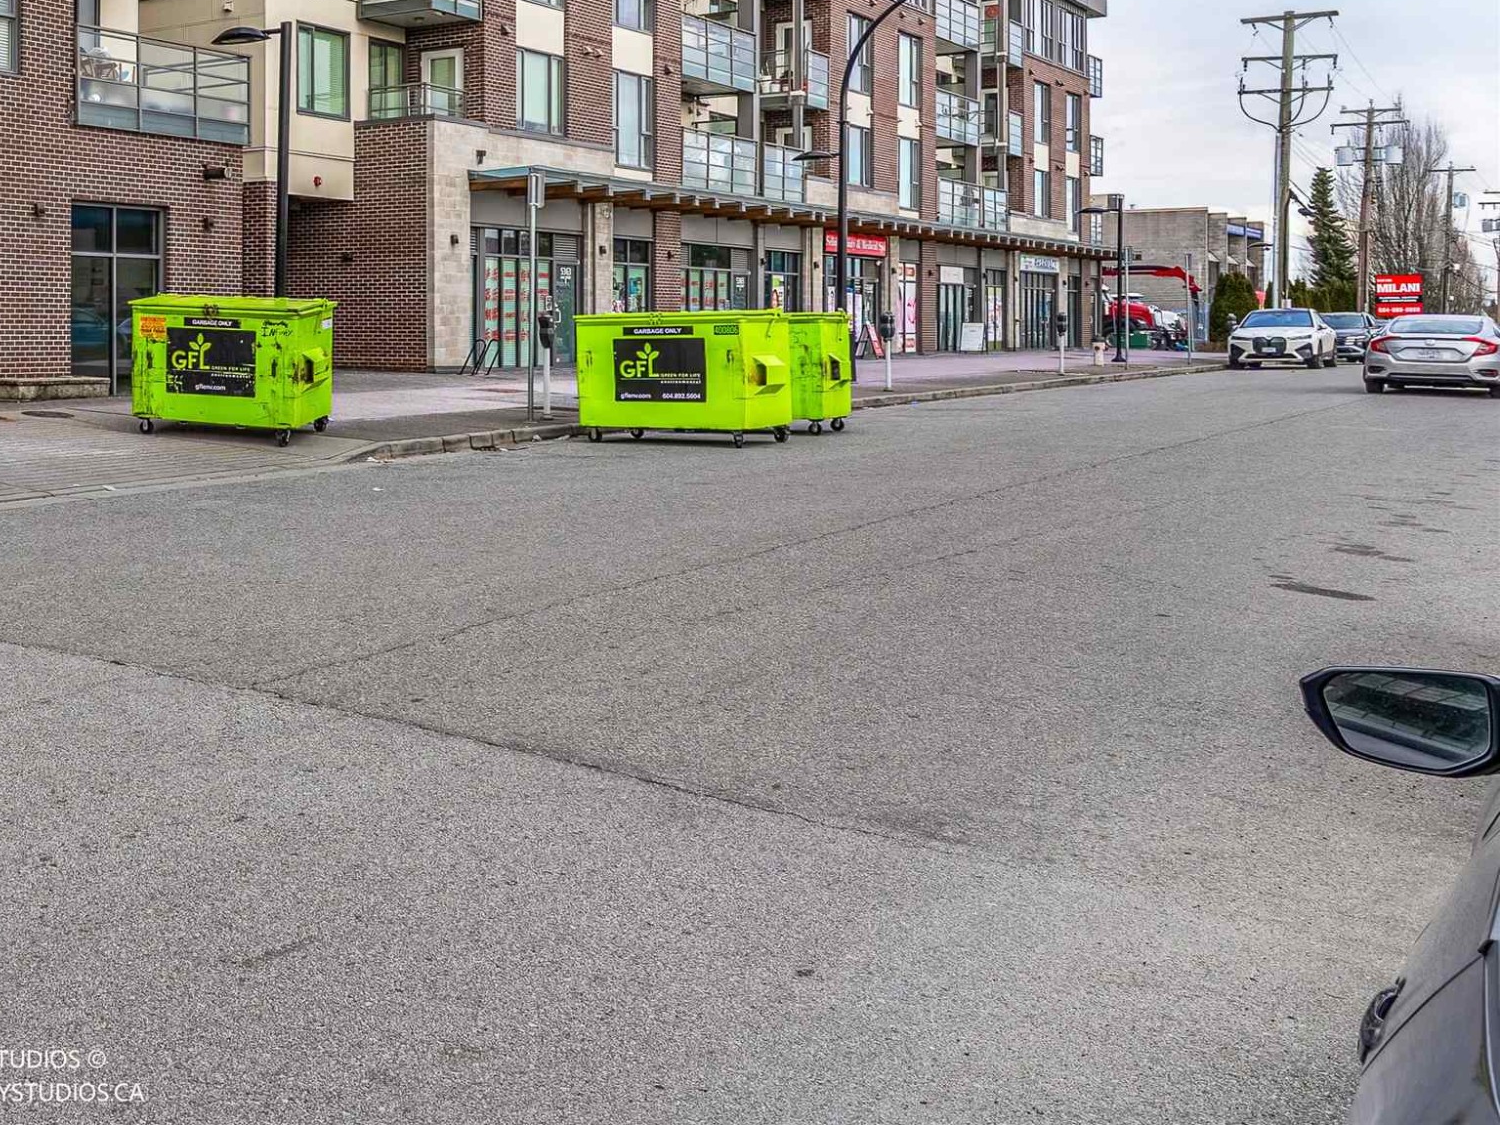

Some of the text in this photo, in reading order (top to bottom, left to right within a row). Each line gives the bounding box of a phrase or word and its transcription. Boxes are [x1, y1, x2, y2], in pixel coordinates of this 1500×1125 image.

[1376, 283, 1421, 293] MILANI
[171, 344, 211, 370] GFL
[620, 355, 659, 378] GFL
